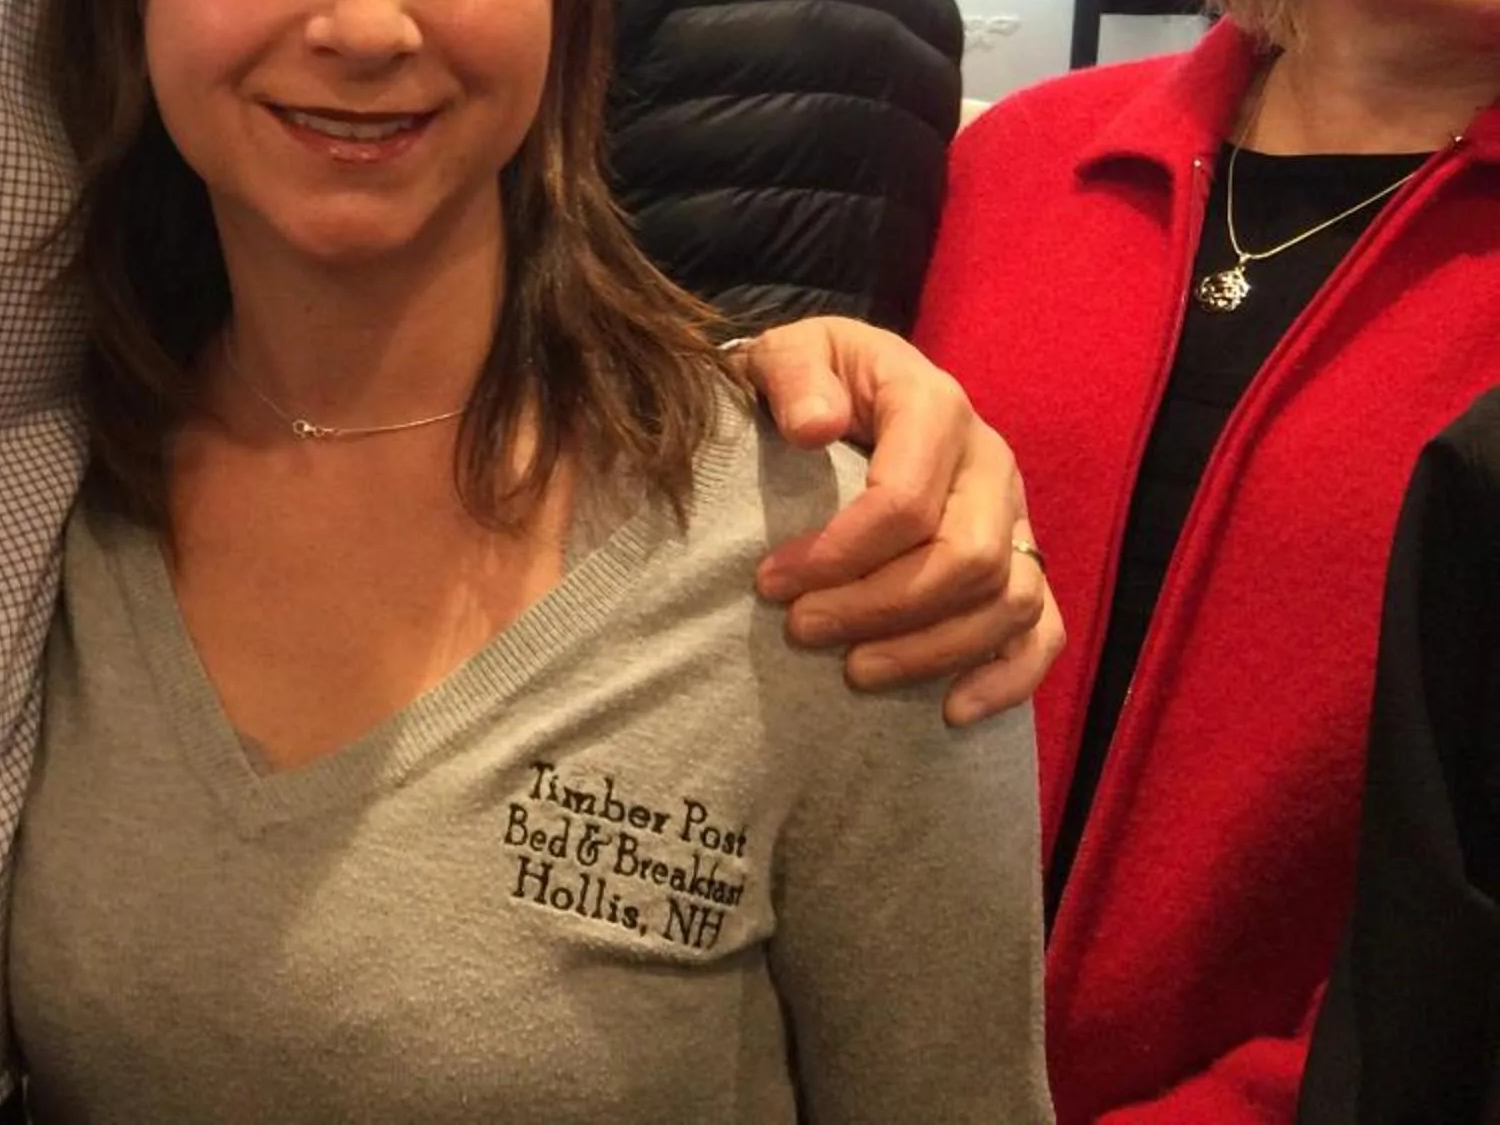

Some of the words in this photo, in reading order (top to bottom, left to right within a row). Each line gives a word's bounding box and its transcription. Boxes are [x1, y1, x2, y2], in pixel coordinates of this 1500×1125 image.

[504, 803, 572, 859] Bed
[577, 823, 613, 867] &
[529, 761, 671, 834] Timber
[680, 798, 747, 858] Post
[511, 856, 648, 937] Hollis,
[661, 896, 726, 951] NH
